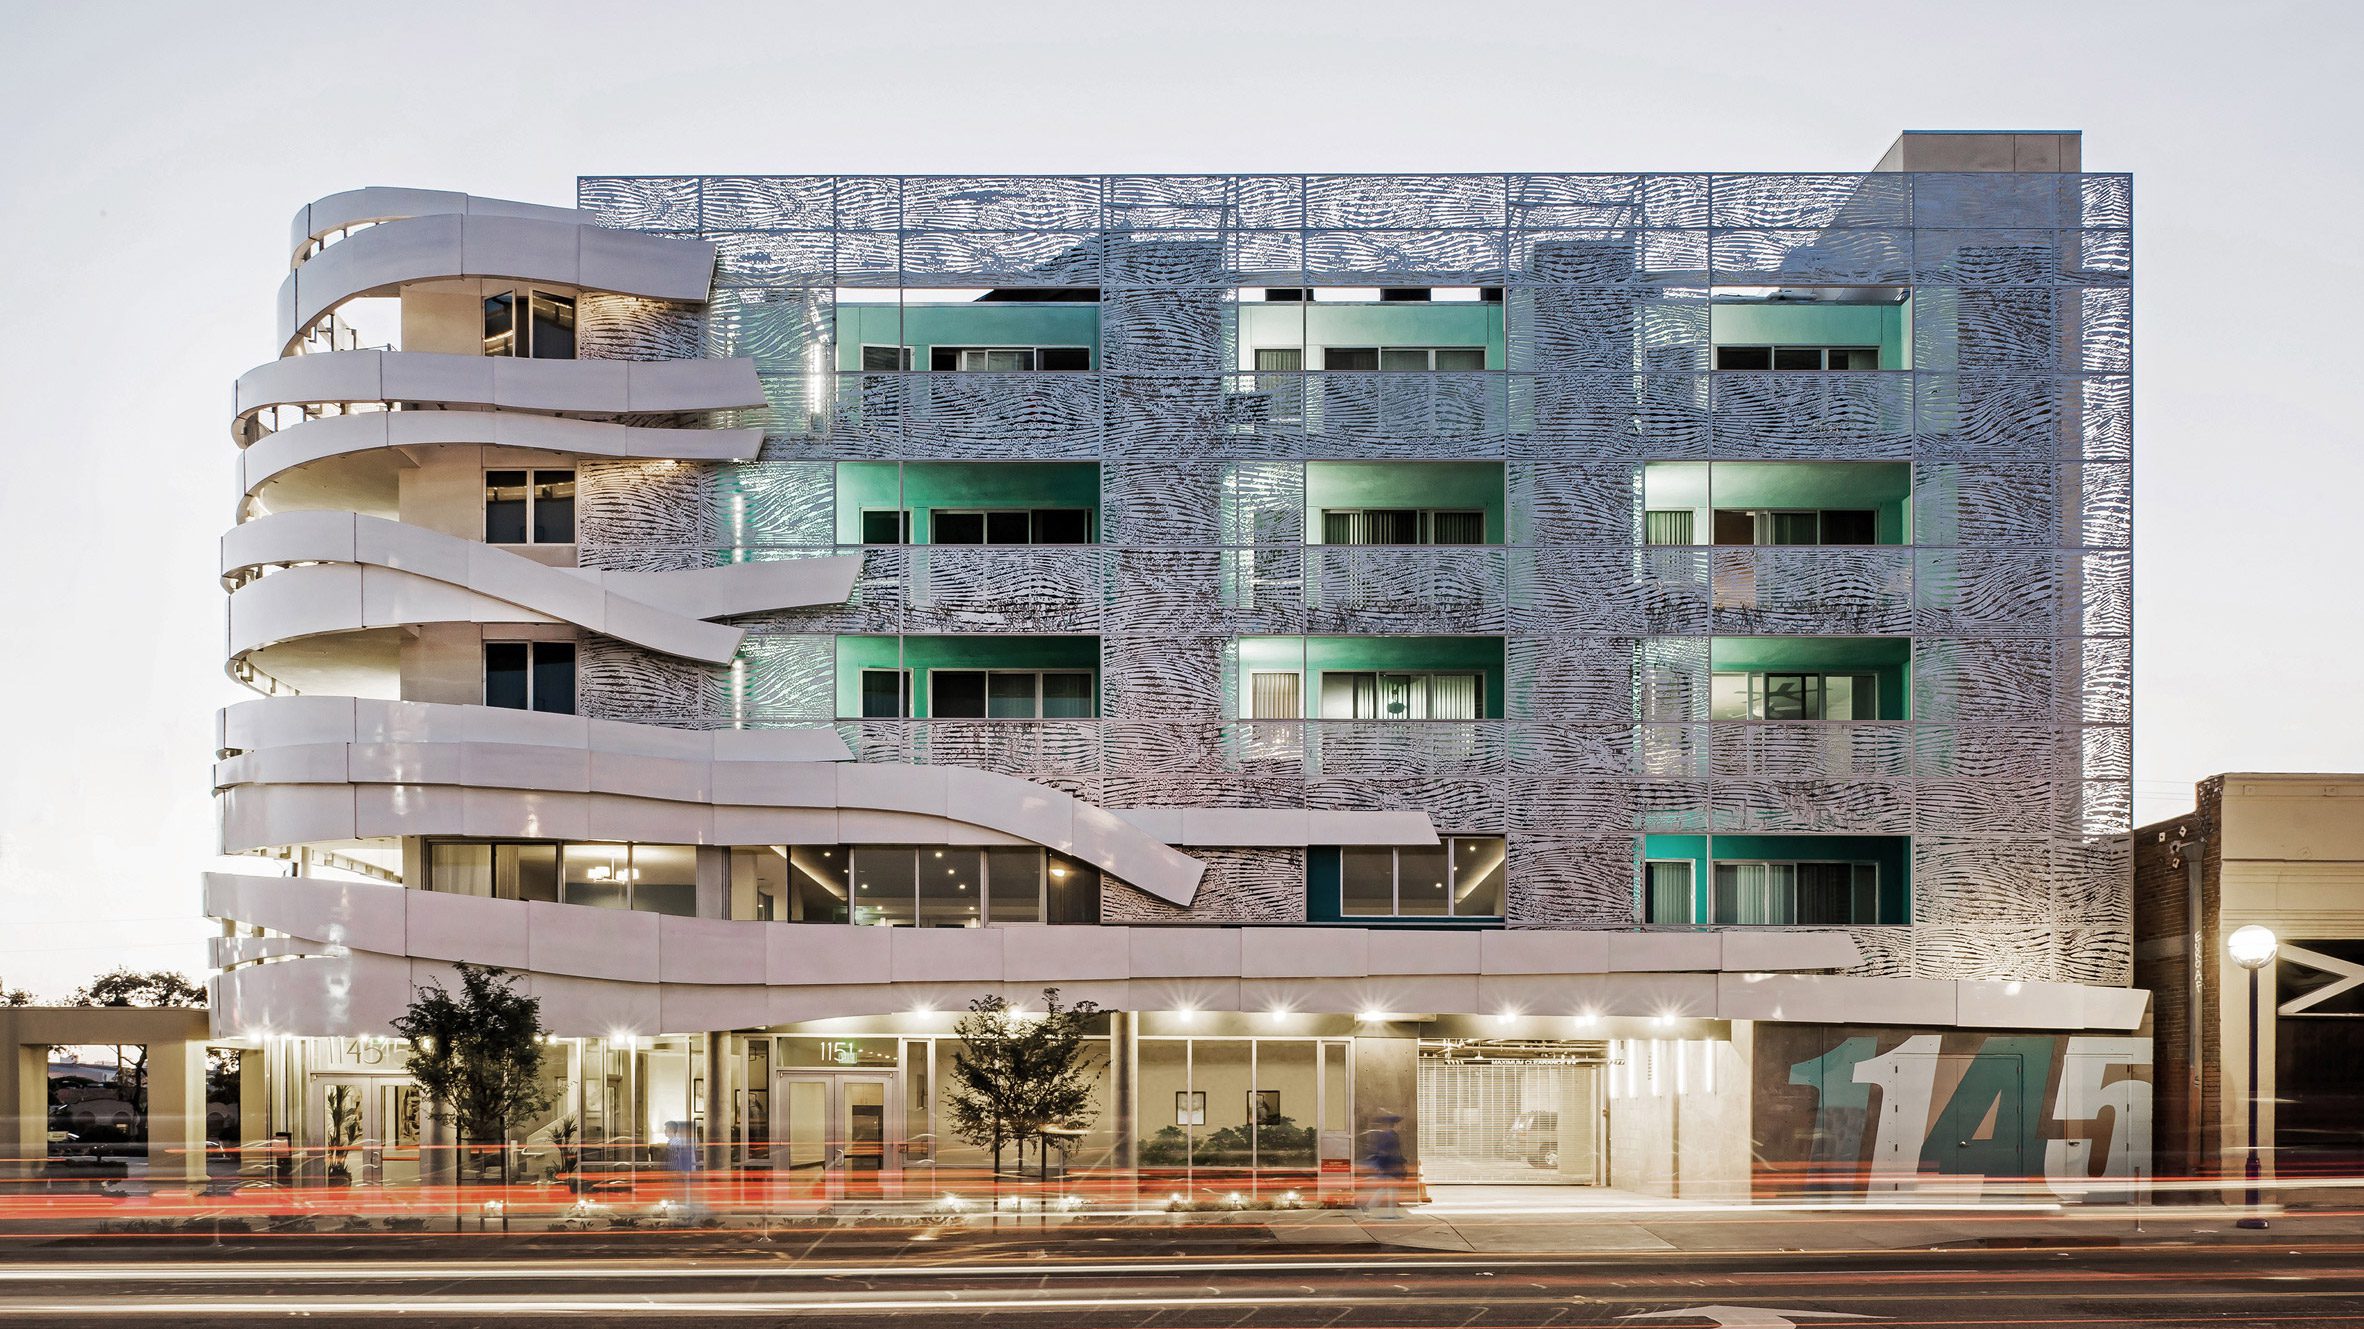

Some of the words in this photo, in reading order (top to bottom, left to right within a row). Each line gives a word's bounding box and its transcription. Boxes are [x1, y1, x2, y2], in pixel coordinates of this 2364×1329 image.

[329, 1038, 384, 1064] 1145
[820, 1041, 853, 1062] 1151
[1788, 1034, 2153, 1204] 1145
